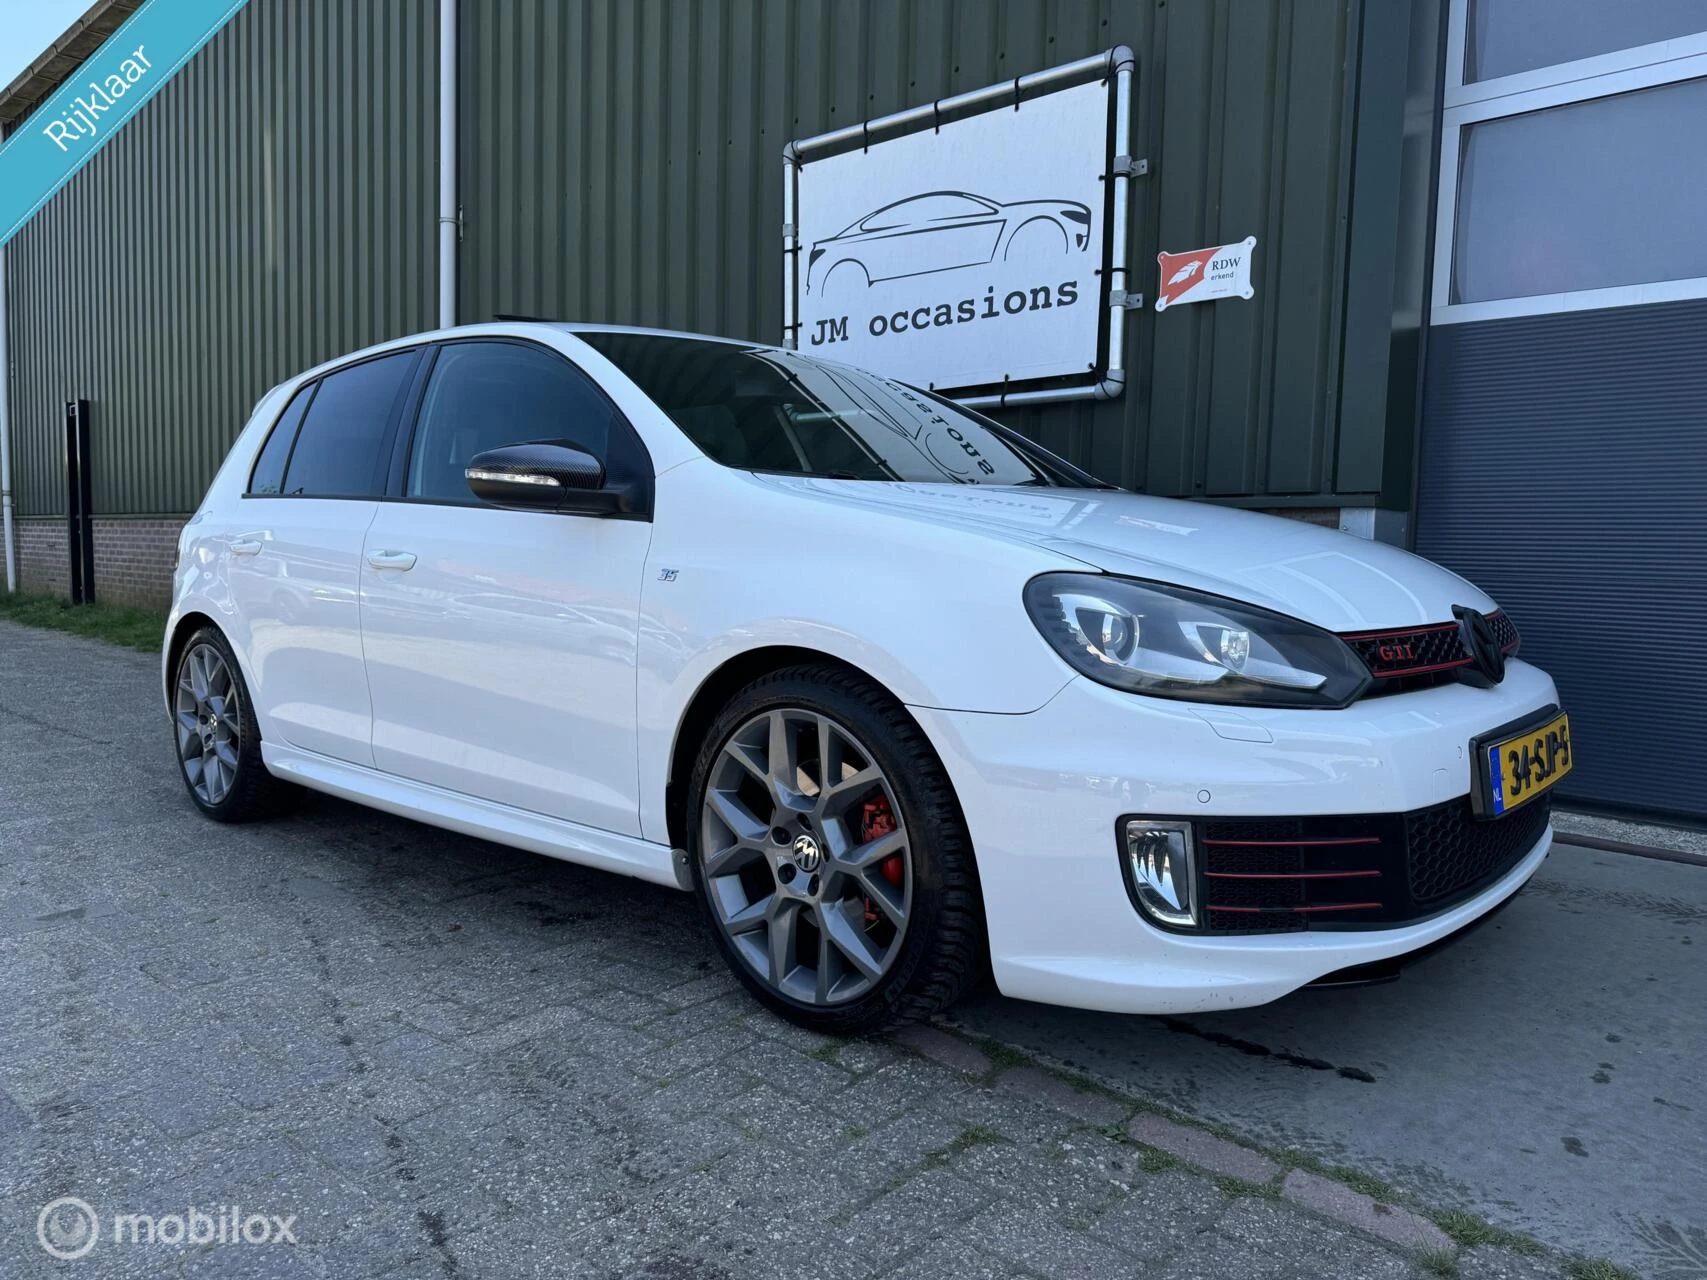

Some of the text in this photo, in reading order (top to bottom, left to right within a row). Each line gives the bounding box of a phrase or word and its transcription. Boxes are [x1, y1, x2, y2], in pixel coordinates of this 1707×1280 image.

[1211, 257, 1241, 271] RDW
[1210, 272, 1234, 281] erkend
[811, 281, 1078, 345] JM occasions
[1379, 645, 1415, 661] GTI
[1493, 725, 1569, 803] NL 34-SJP-5
